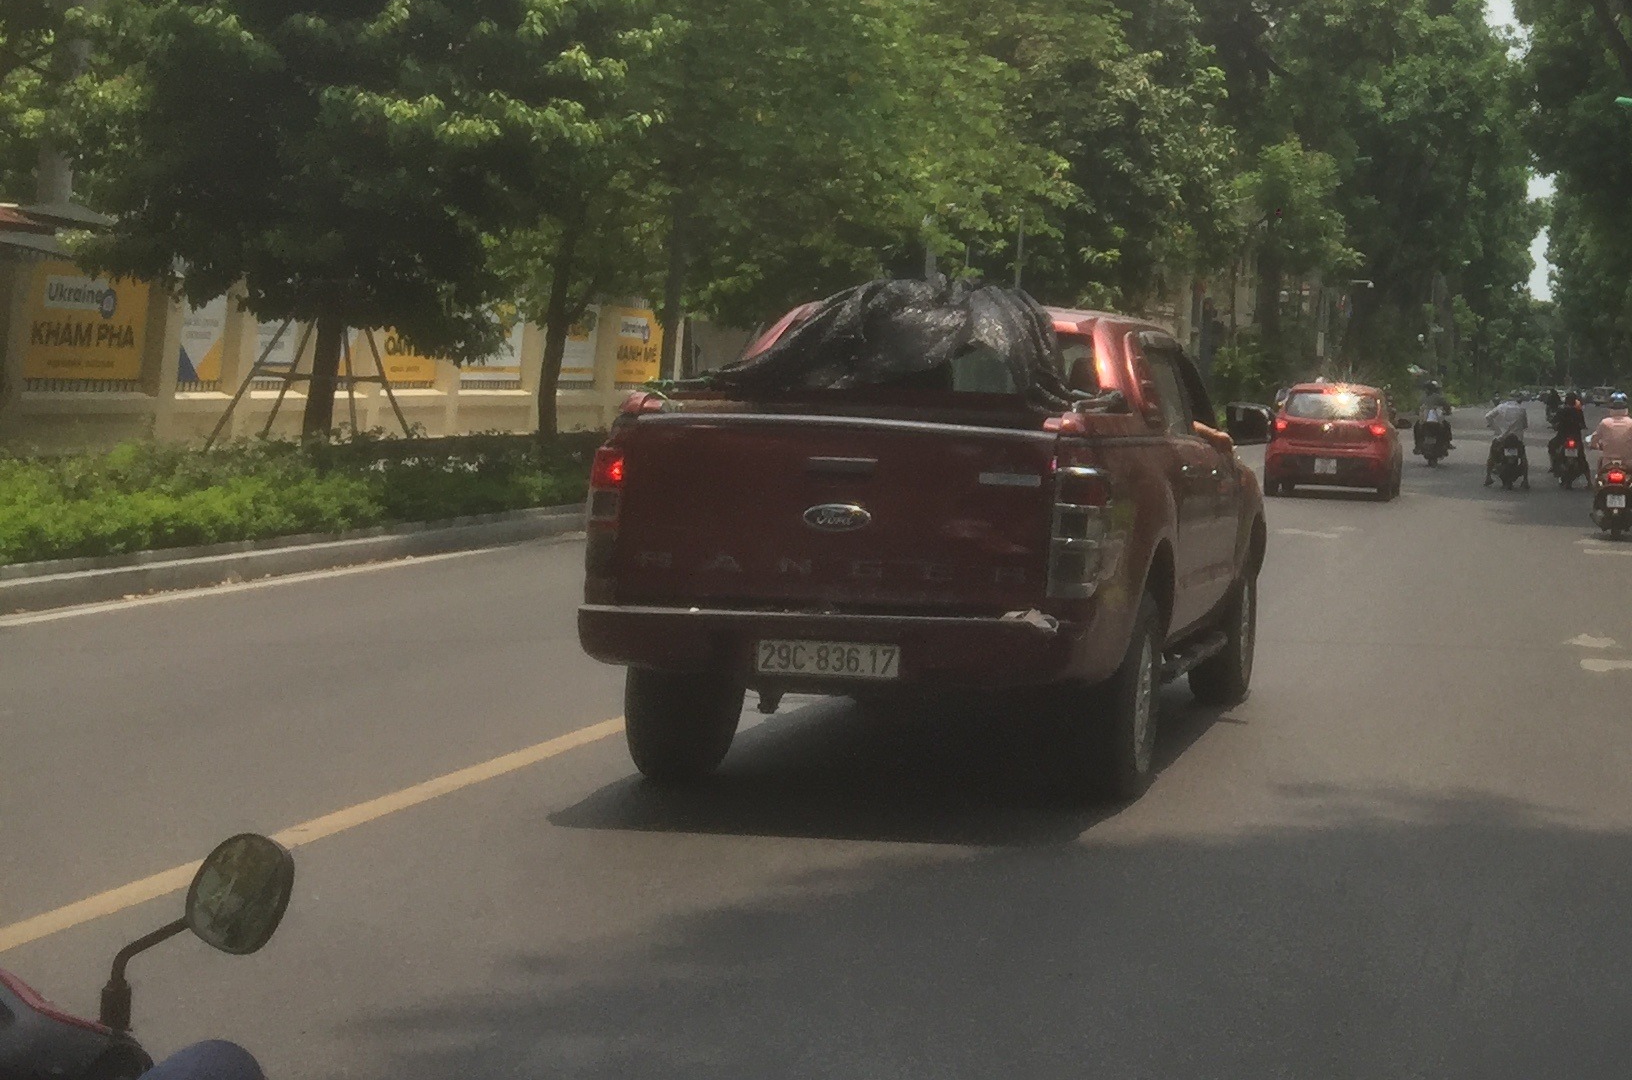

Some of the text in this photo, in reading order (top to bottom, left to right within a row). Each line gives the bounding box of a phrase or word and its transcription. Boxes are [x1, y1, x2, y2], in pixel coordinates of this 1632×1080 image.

[48, 282, 103, 304] Ukraine
[31, 314, 134, 348] KHÁM PHÁ
